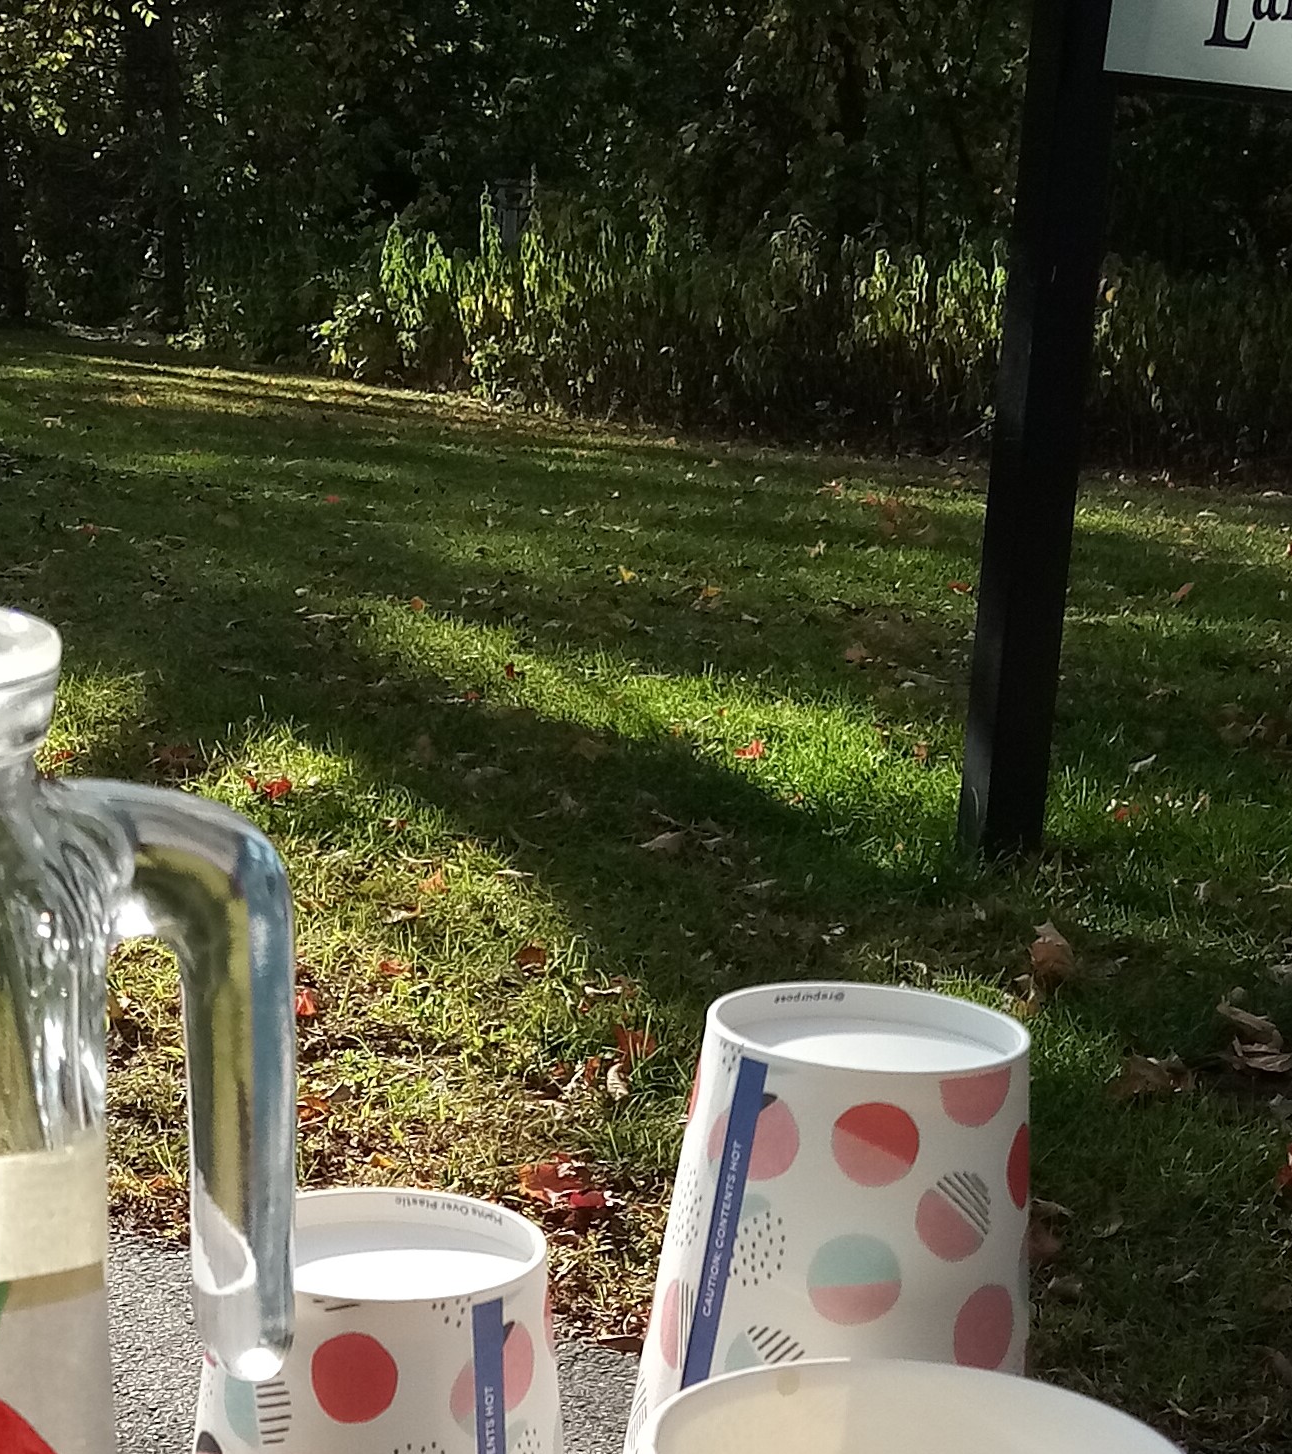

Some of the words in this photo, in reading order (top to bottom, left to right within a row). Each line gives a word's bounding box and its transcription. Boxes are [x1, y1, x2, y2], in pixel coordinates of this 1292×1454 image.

[395, 1196, 438, 1210] Plastic
[441, 1202, 469, 1216] Over
[702, 1251, 722, 1318] CAUTION:
[715, 1174, 736, 1250] CONTENTS
[729, 1139, 742, 1172] HOT
[484, 1385, 495, 1417] HOT
